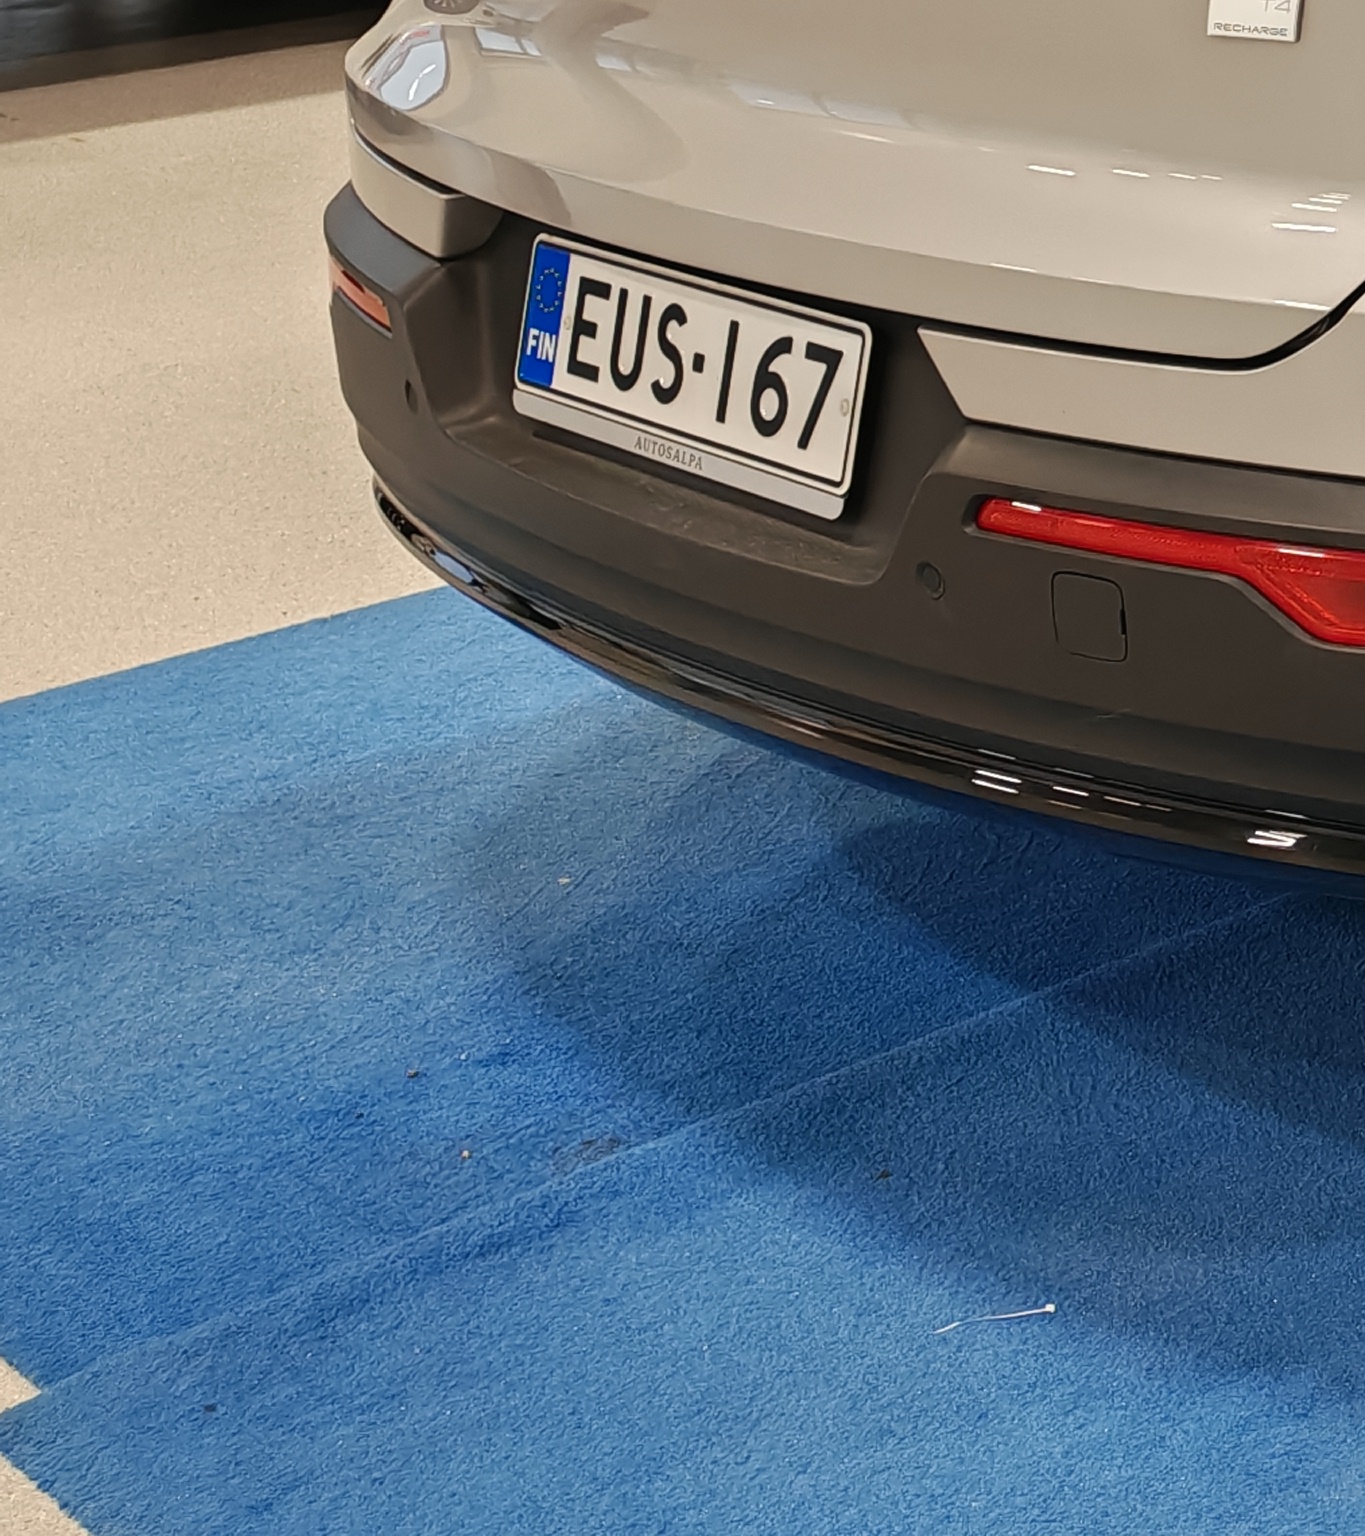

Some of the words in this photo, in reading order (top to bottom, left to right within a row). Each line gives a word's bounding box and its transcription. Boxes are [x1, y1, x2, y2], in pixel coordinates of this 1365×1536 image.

[1213, 22, 1288, 37] RECHARGE
[526, 327, 557, 363] FIN
[634, 435, 704, 471] AUTOSALPA
